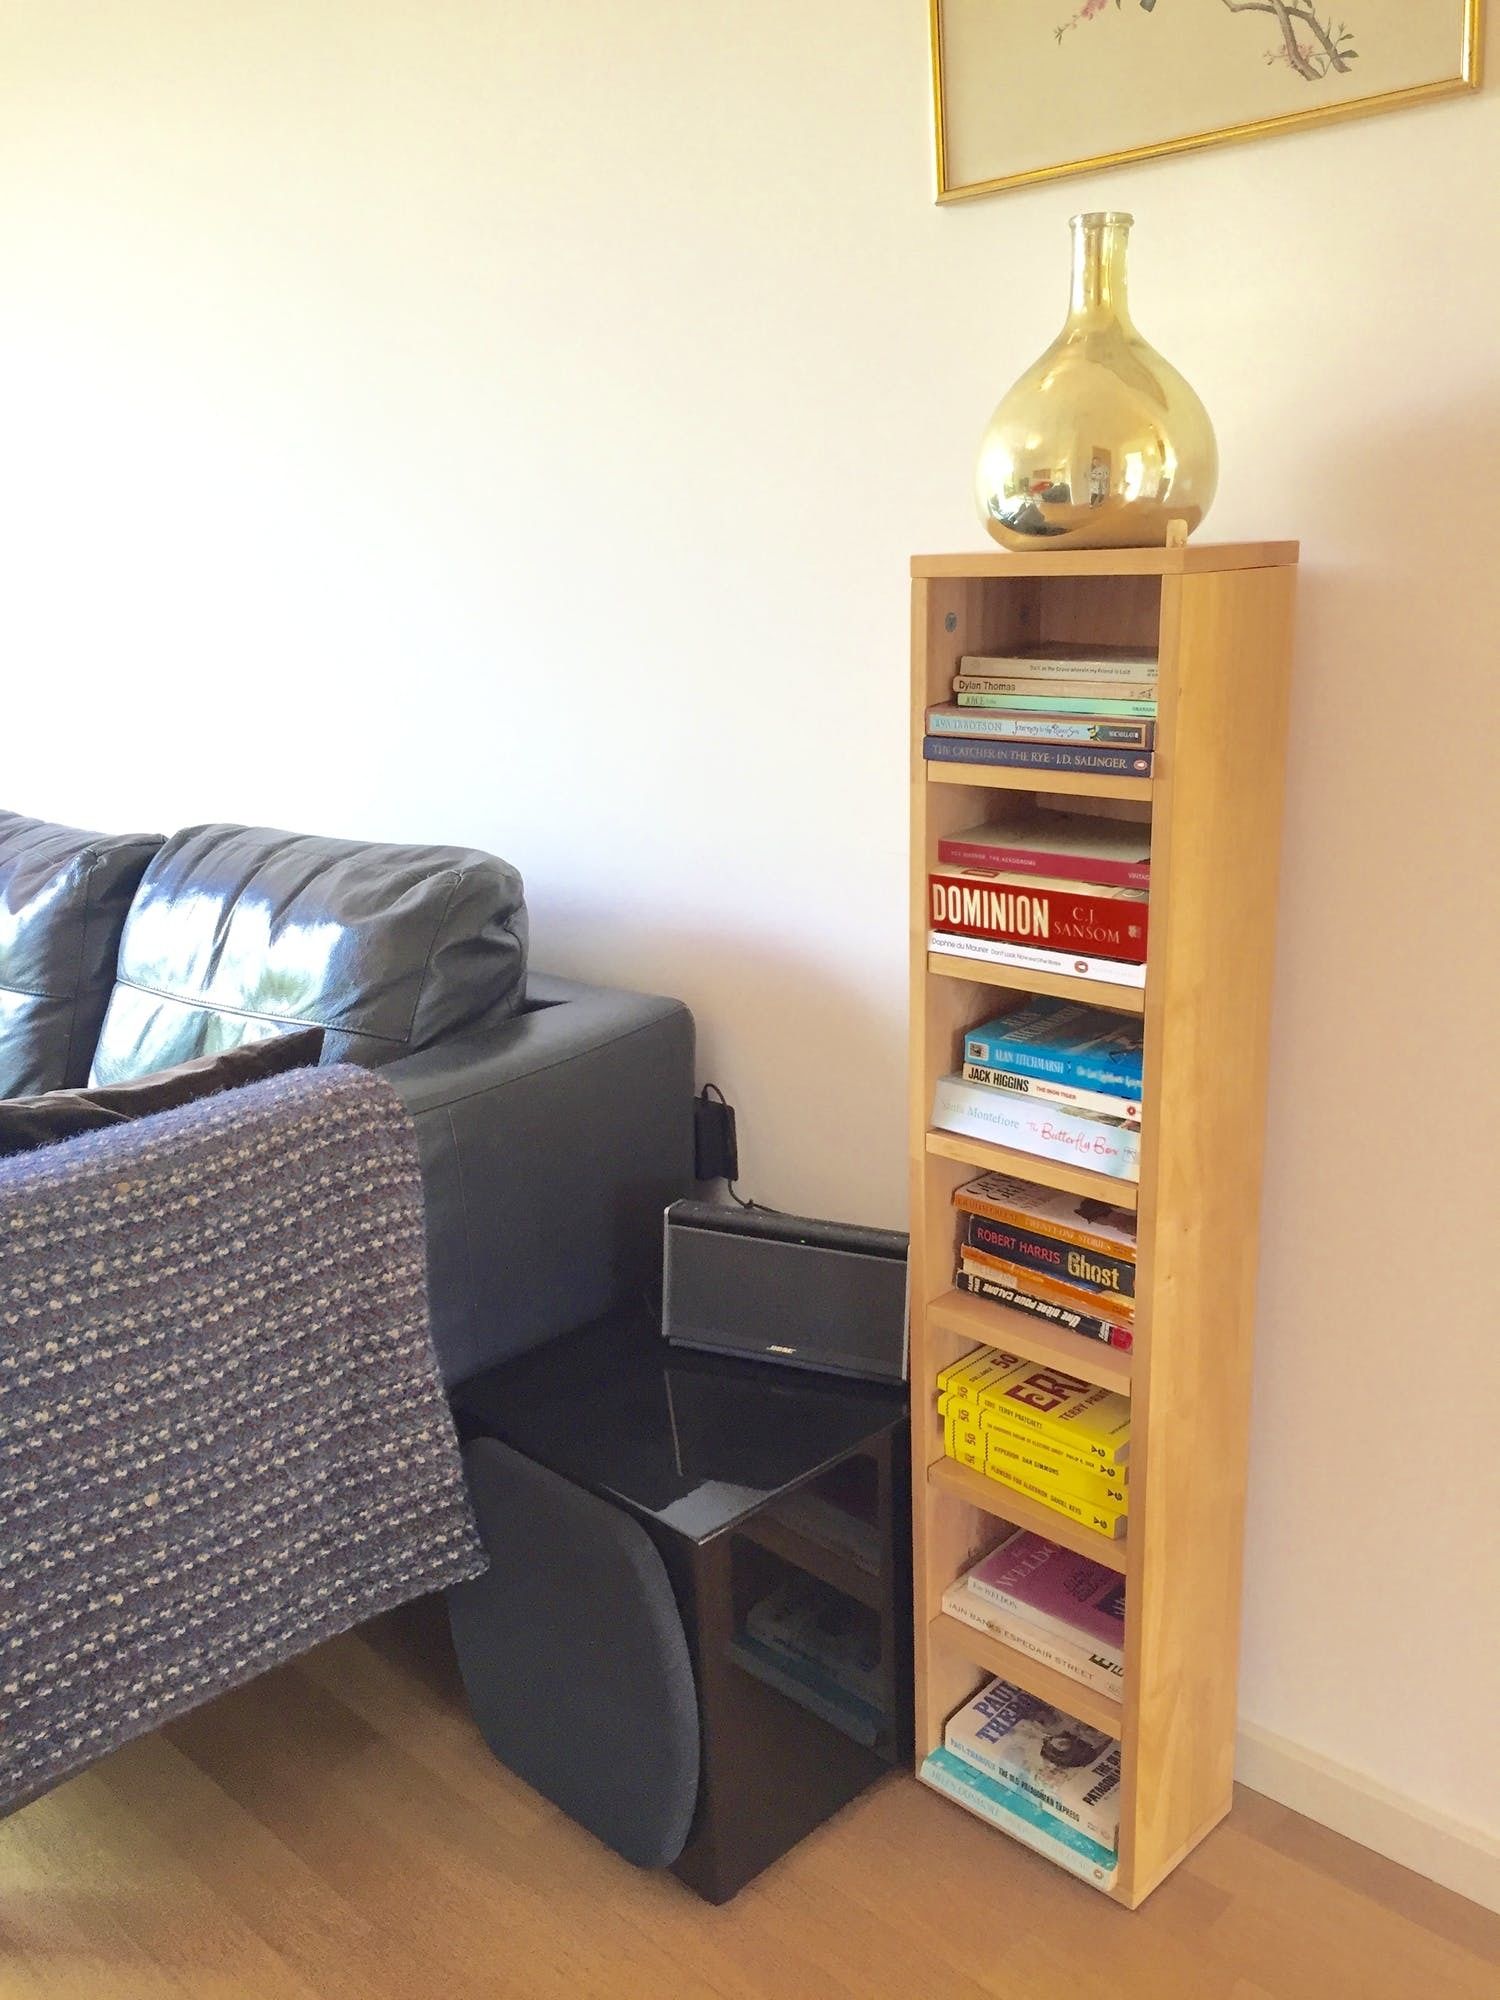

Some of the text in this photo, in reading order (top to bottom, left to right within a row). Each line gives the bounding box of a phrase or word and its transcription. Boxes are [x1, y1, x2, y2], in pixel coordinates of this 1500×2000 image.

[958, 680, 1016, 692] Dylan Thomas
[933, 743, 951, 754] THE
[952, 746, 996, 759] CATCHER
[997, 749, 1008, 760] IN
[1010, 750, 1027, 760] THE
[1031, 751, 1050, 763] RYE
[1074, 755, 1128, 769] SALINGER
[932, 883, 1050, 939] DOMINION
[1054, 921, 1120, 944] SANSOM
[931, 937, 955, 950] Daphne
[956, 942, 965, 950] du
[995, 1047, 1014, 1062] ALAN
[968, 1067, 1030, 1093] JACK HIGGINS
[1036, 1085, 1046, 1093] THE
[1060, 1090, 1077, 1100] TIGER
[967, 1104, 1020, 1129] Montefiore
[1040, 1121, 1091, 1154] Butterfly
[1093, 1135, 1120, 1156] Box
[976, 1226, 1062, 1265] ROBERT HARRIS
[1067, 1250, 1120, 1291] Ghost
[990, 1353, 1019, 1369] 50
[959, 1386, 969, 1400] 50
[960, 1409, 970, 1423] 50
[998, 1404, 1014, 1418] TERRY
[1014, 1411, 1043, 1430] PRATCHETT
[1057, 1401, 1089, 1421] TERRY
[967, 1432, 977, 1447] 50
[1021, 1456, 1033, 1467] DAN
[1033, 1460, 1060, 1476] SIMMONS
[984, 1588, 1018, 1610] WELDON
[949, 1602, 968, 1616] IAIN
[969, 1612, 1002, 1634] BANKS
[1004, 1629, 1053, 1660] ESPEDAIR
[1054, 1656, 1095, 1681] STREET
[1091, 1761, 1114, 1778] THE
[998, 1766, 1009, 1779] THE
[1009, 1773, 1020, 1785] OLD
[1055, 1800, 1080, 1823] EXPRESS
